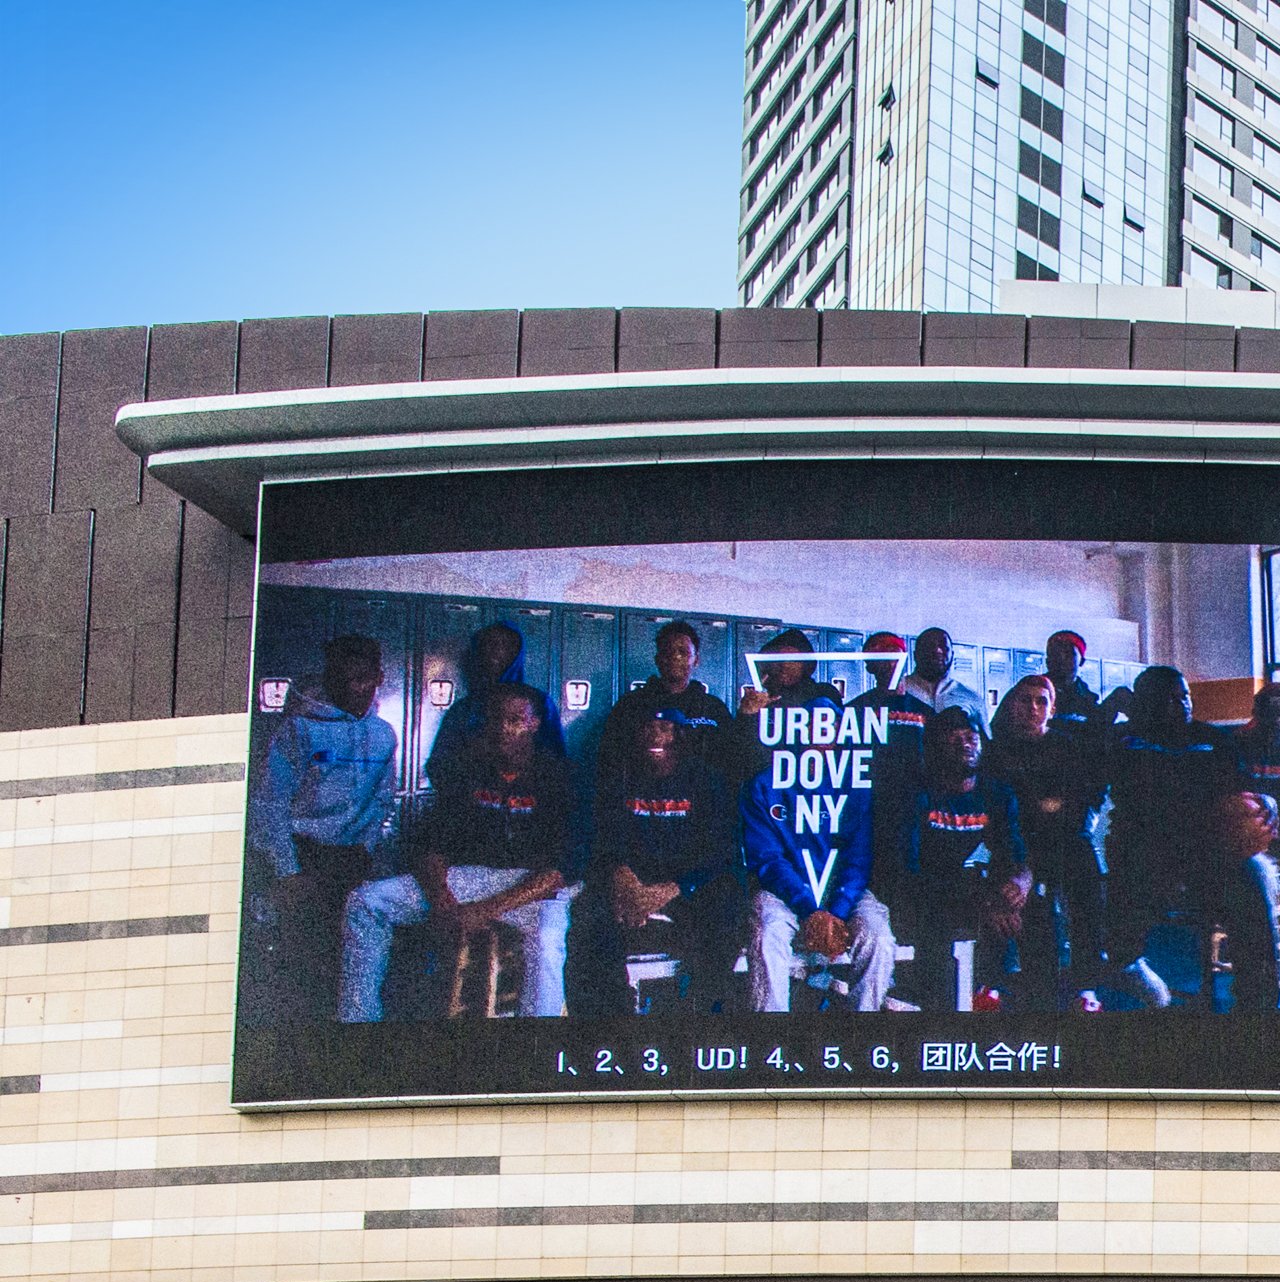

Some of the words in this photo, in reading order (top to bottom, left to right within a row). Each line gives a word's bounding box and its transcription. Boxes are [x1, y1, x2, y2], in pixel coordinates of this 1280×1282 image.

[759, 707, 889, 746] URBAN
[772, 750, 873, 789] DOVE
[795, 795, 848, 834] NY
